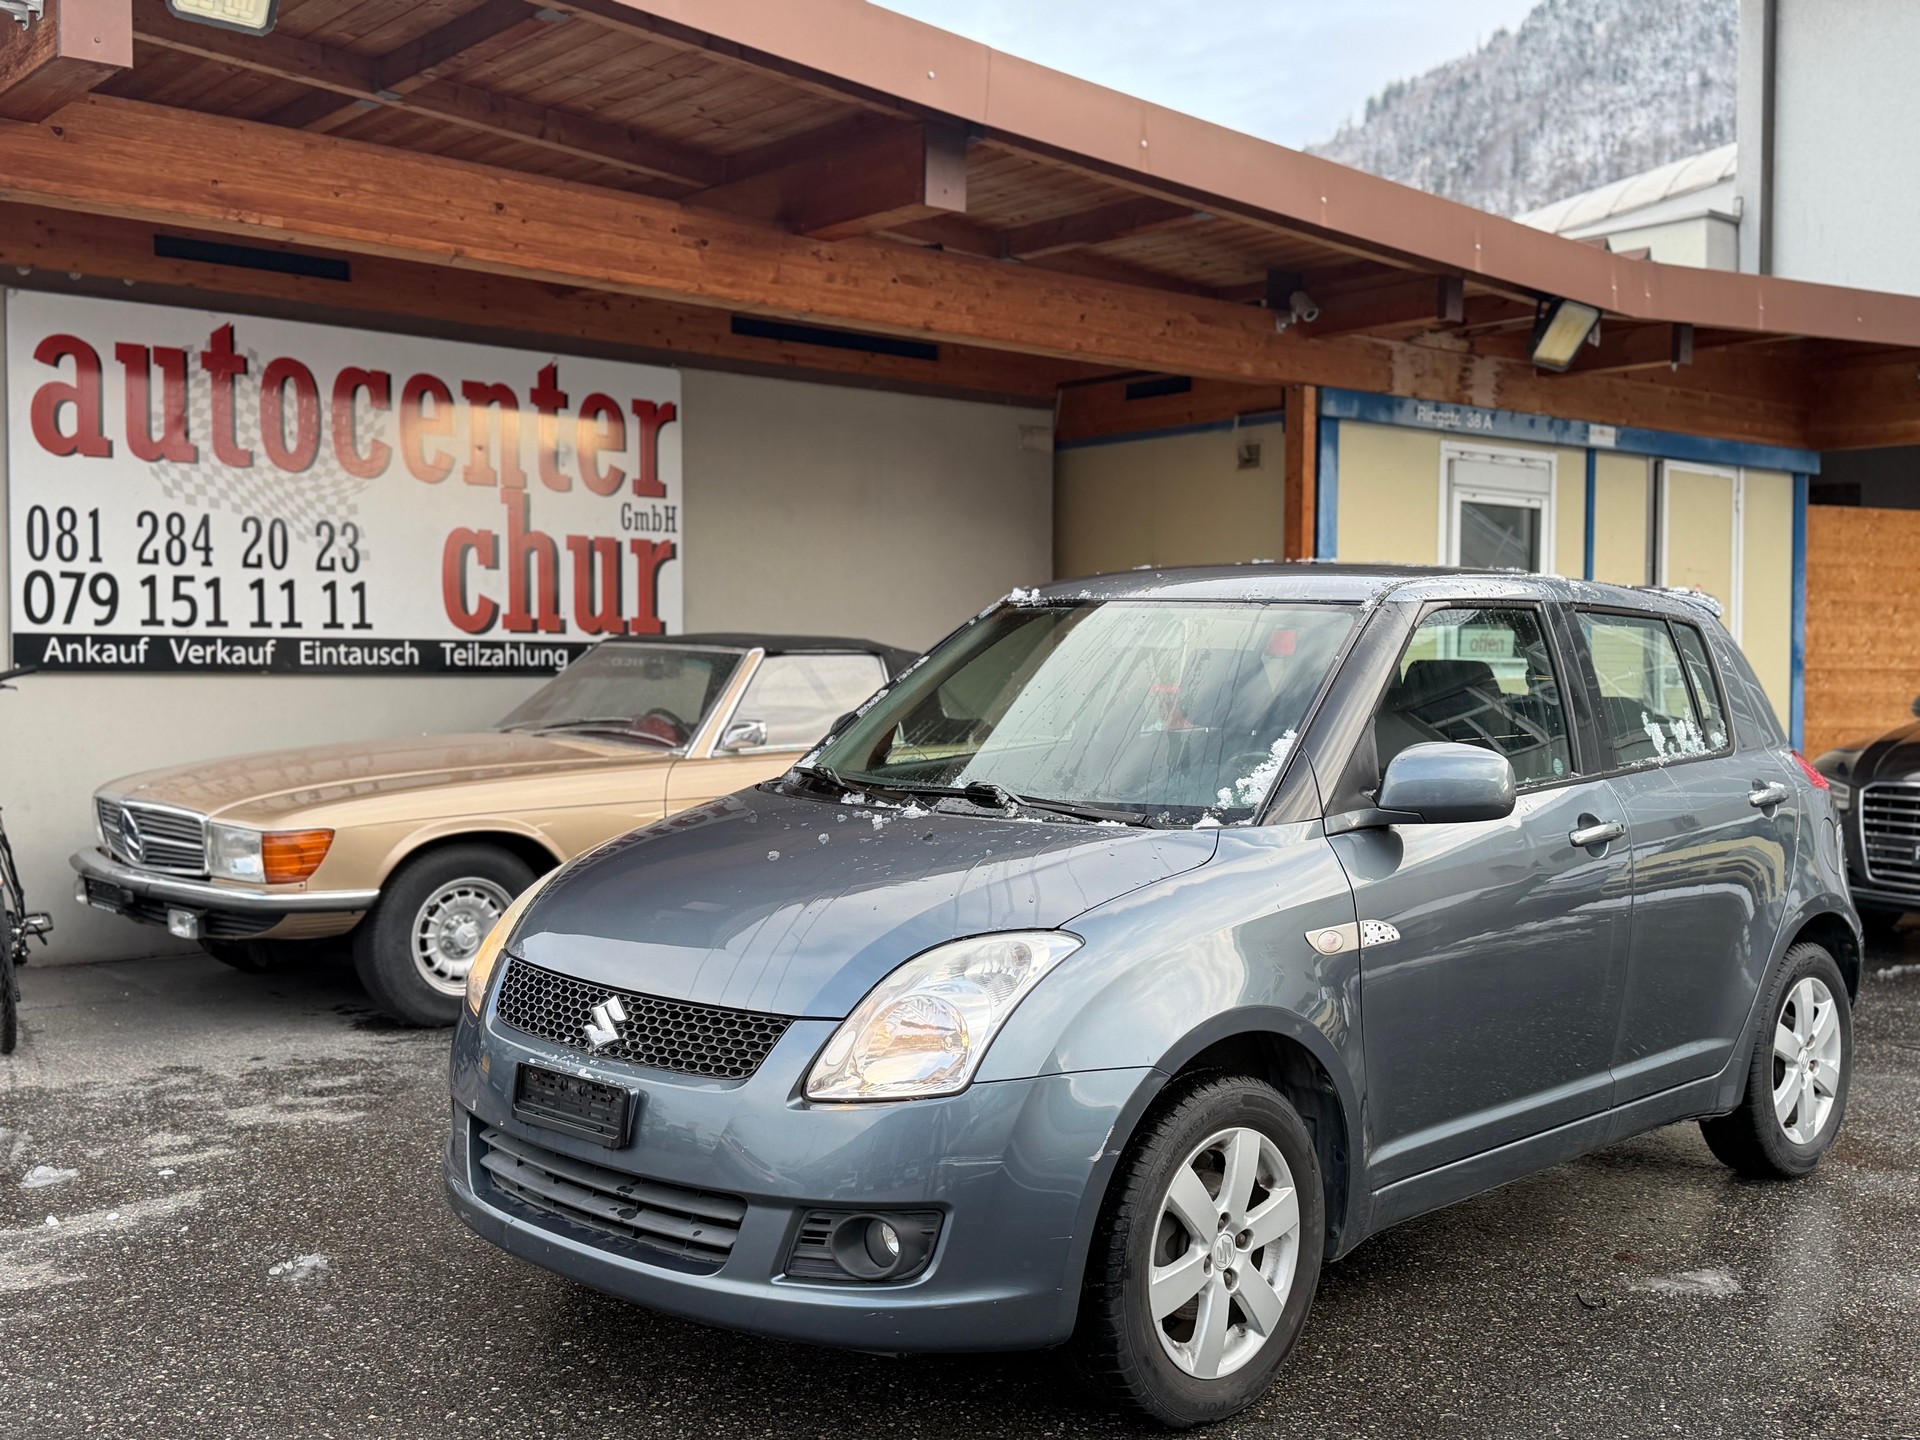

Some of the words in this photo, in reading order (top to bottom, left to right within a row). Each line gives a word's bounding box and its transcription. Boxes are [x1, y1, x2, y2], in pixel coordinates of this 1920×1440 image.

[30, 321, 677, 498] autocenter
[1483, 413, 1493, 430] A
[26, 504, 103, 563] 081
[136, 510, 213, 567] 284
[241, 516, 289, 570] 20
[315, 520, 360, 573] 23
[621, 502, 678, 533] GmbH
[442, 487, 677, 636] chur
[23, 569, 120, 627] 079
[139, 574, 229, 628] 151
[248, 578, 303, 629] 11
[321, 580, 374, 630] 11
[43, 636, 150, 664] Ankauf
[169, 638, 277, 666] Verkauf
[299, 640, 419, 668] Eintausch
[440, 642, 569, 671] Teilzahlung
[1470, 632, 1505, 653] offen
